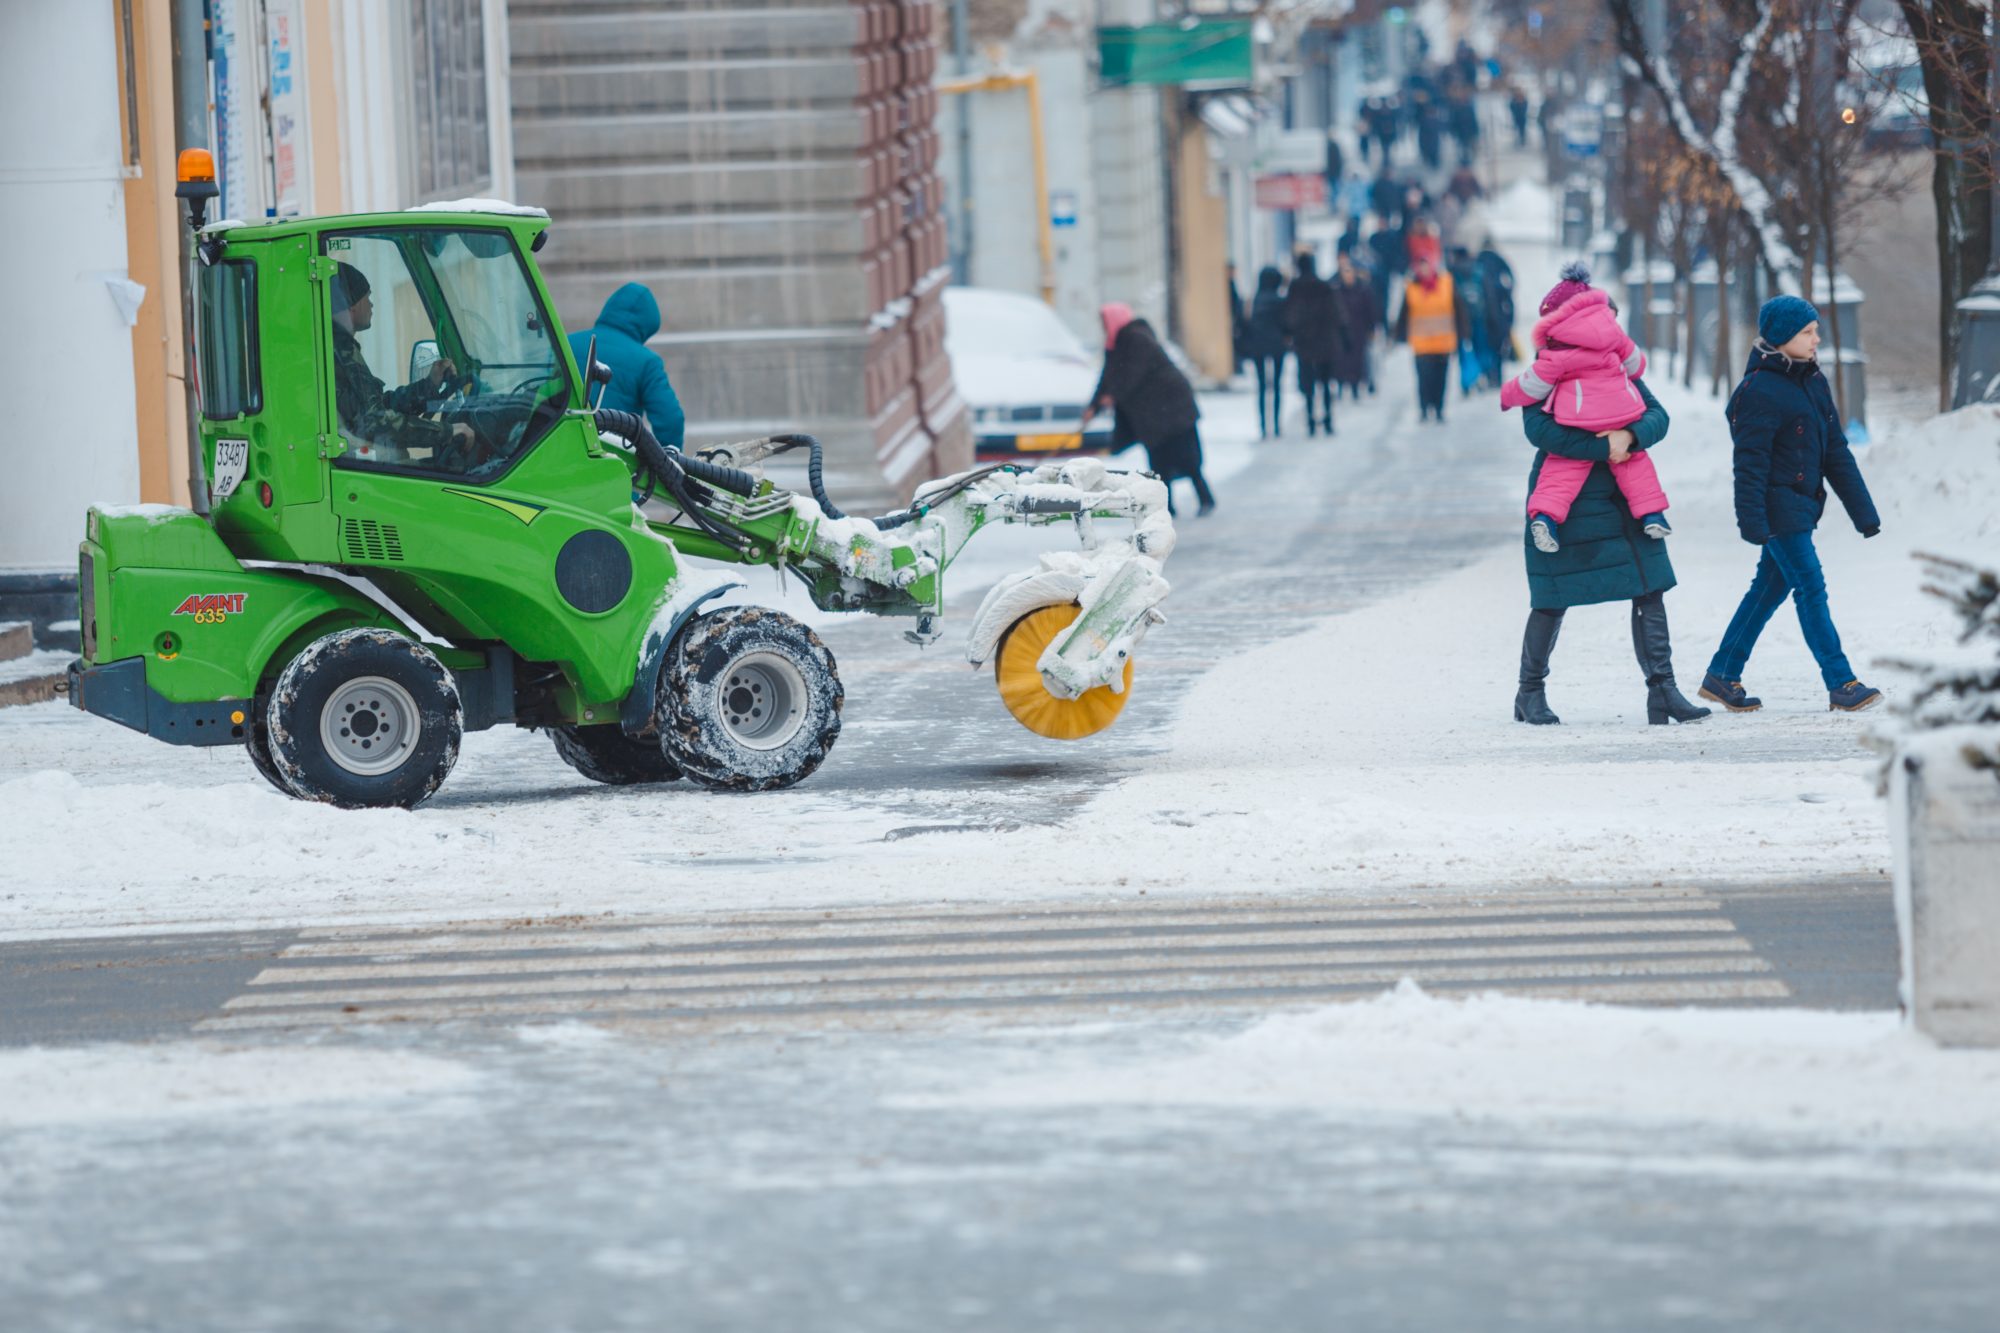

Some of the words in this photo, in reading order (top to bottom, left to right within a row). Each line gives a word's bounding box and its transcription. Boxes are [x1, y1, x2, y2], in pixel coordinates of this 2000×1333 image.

[217, 443, 246, 467] 33487
[217, 475, 233, 493] AB
[172, 593, 247, 615] AVANT
[194, 607, 226, 624] 635
